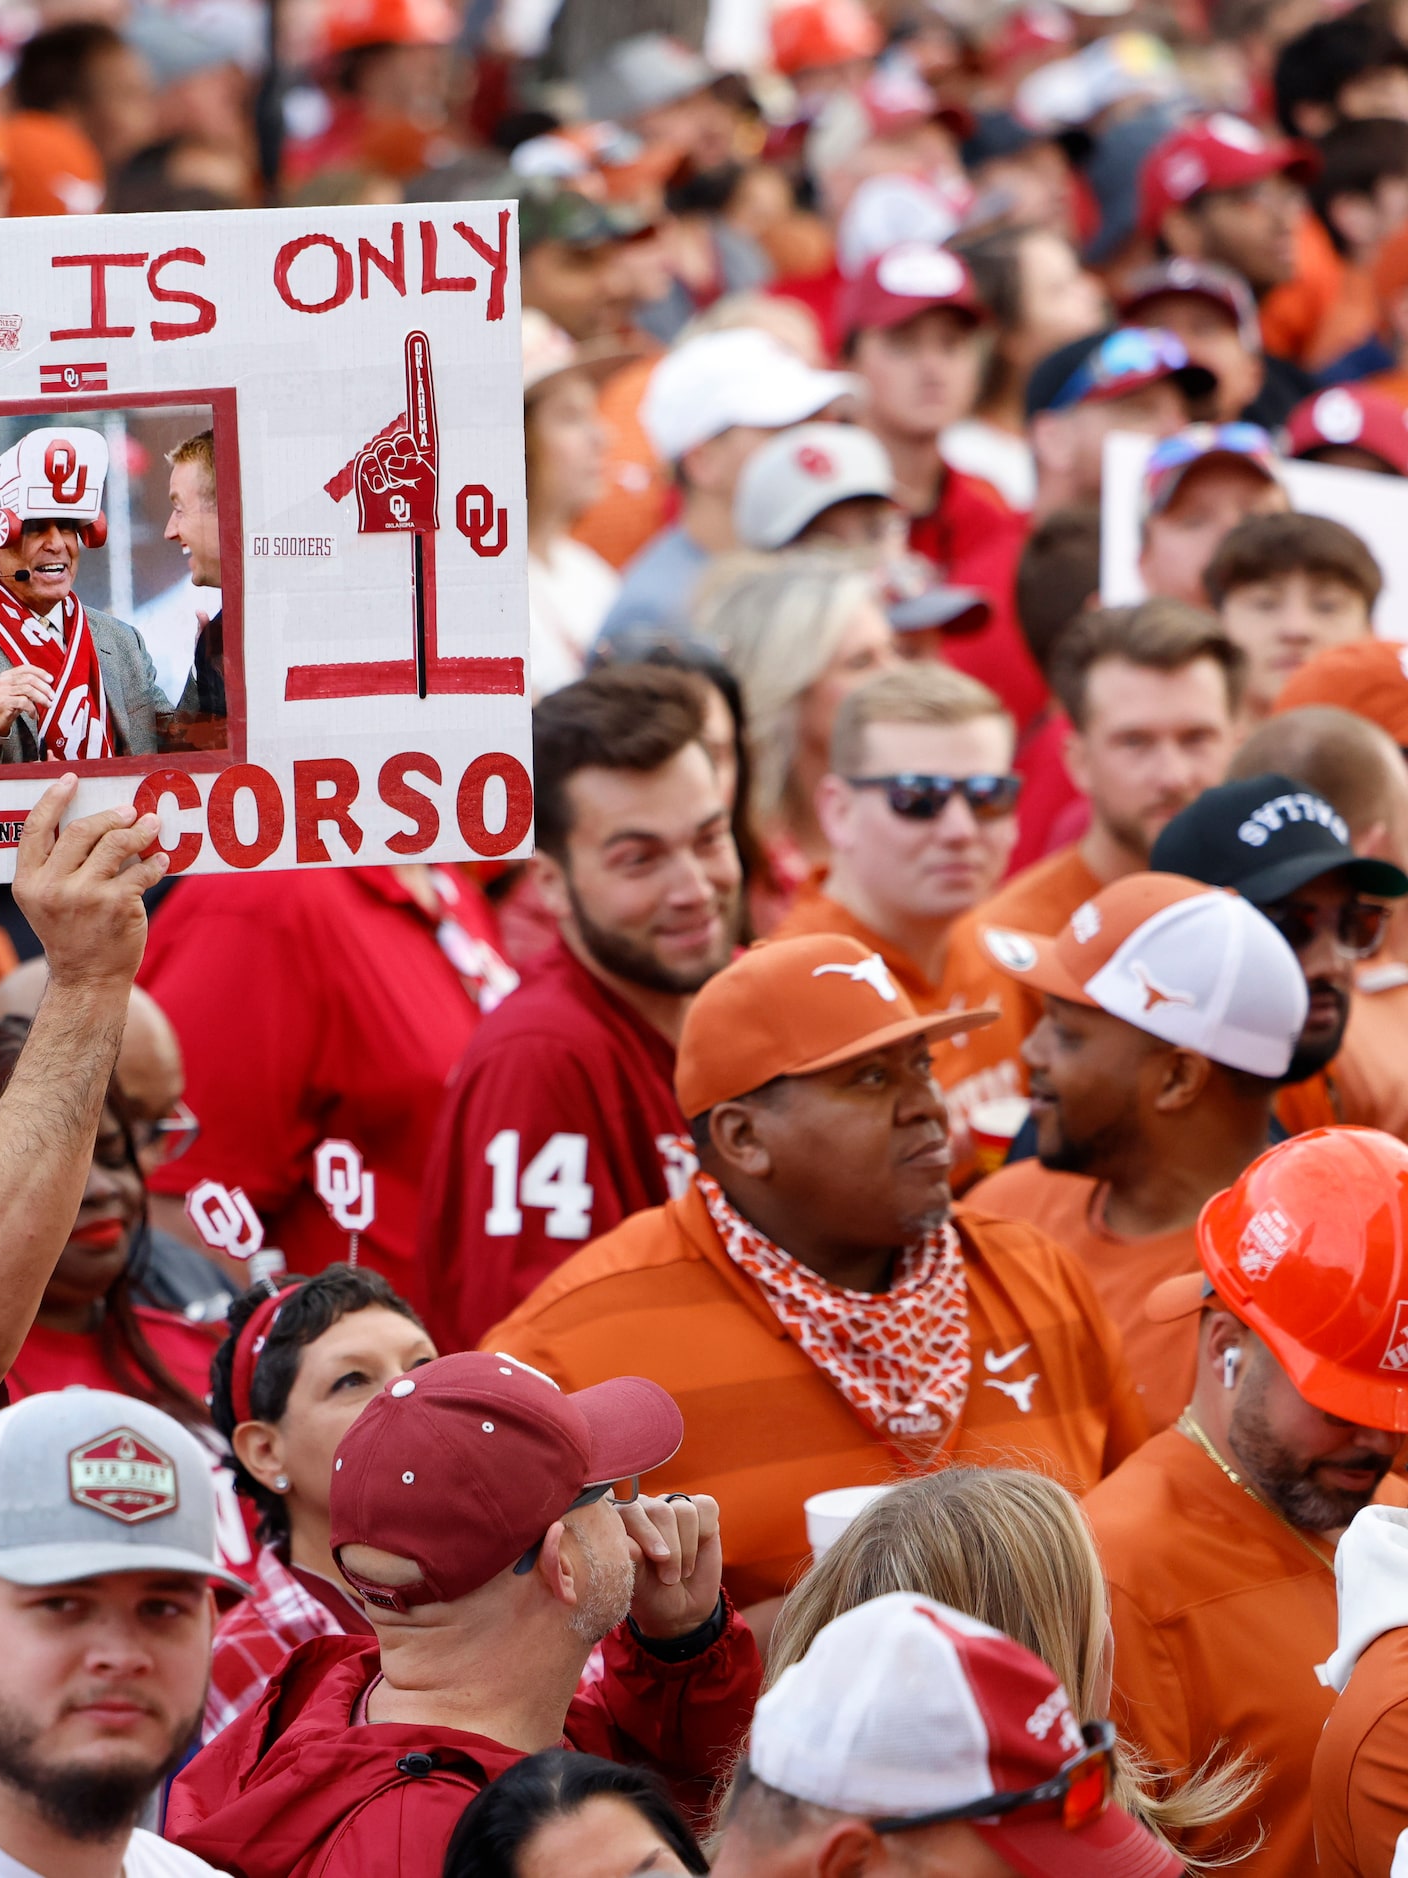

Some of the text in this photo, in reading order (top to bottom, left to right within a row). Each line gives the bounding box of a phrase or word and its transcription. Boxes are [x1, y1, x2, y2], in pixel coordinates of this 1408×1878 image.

[50, 247, 217, 341] IS
[274, 208, 511, 321] ONLY
[414, 341, 430, 448] OKLAHOMA
[253, 537, 332, 556] GO SOONERS
[385, 522, 415, 530] OKLAHOMA
[456, 484, 507, 557] OU
[133, 751, 533, 875] CORSO
[185, 1178, 265, 1260] OU
[314, 1138, 375, 1232] OU
[485, 1129, 594, 1240] 14
